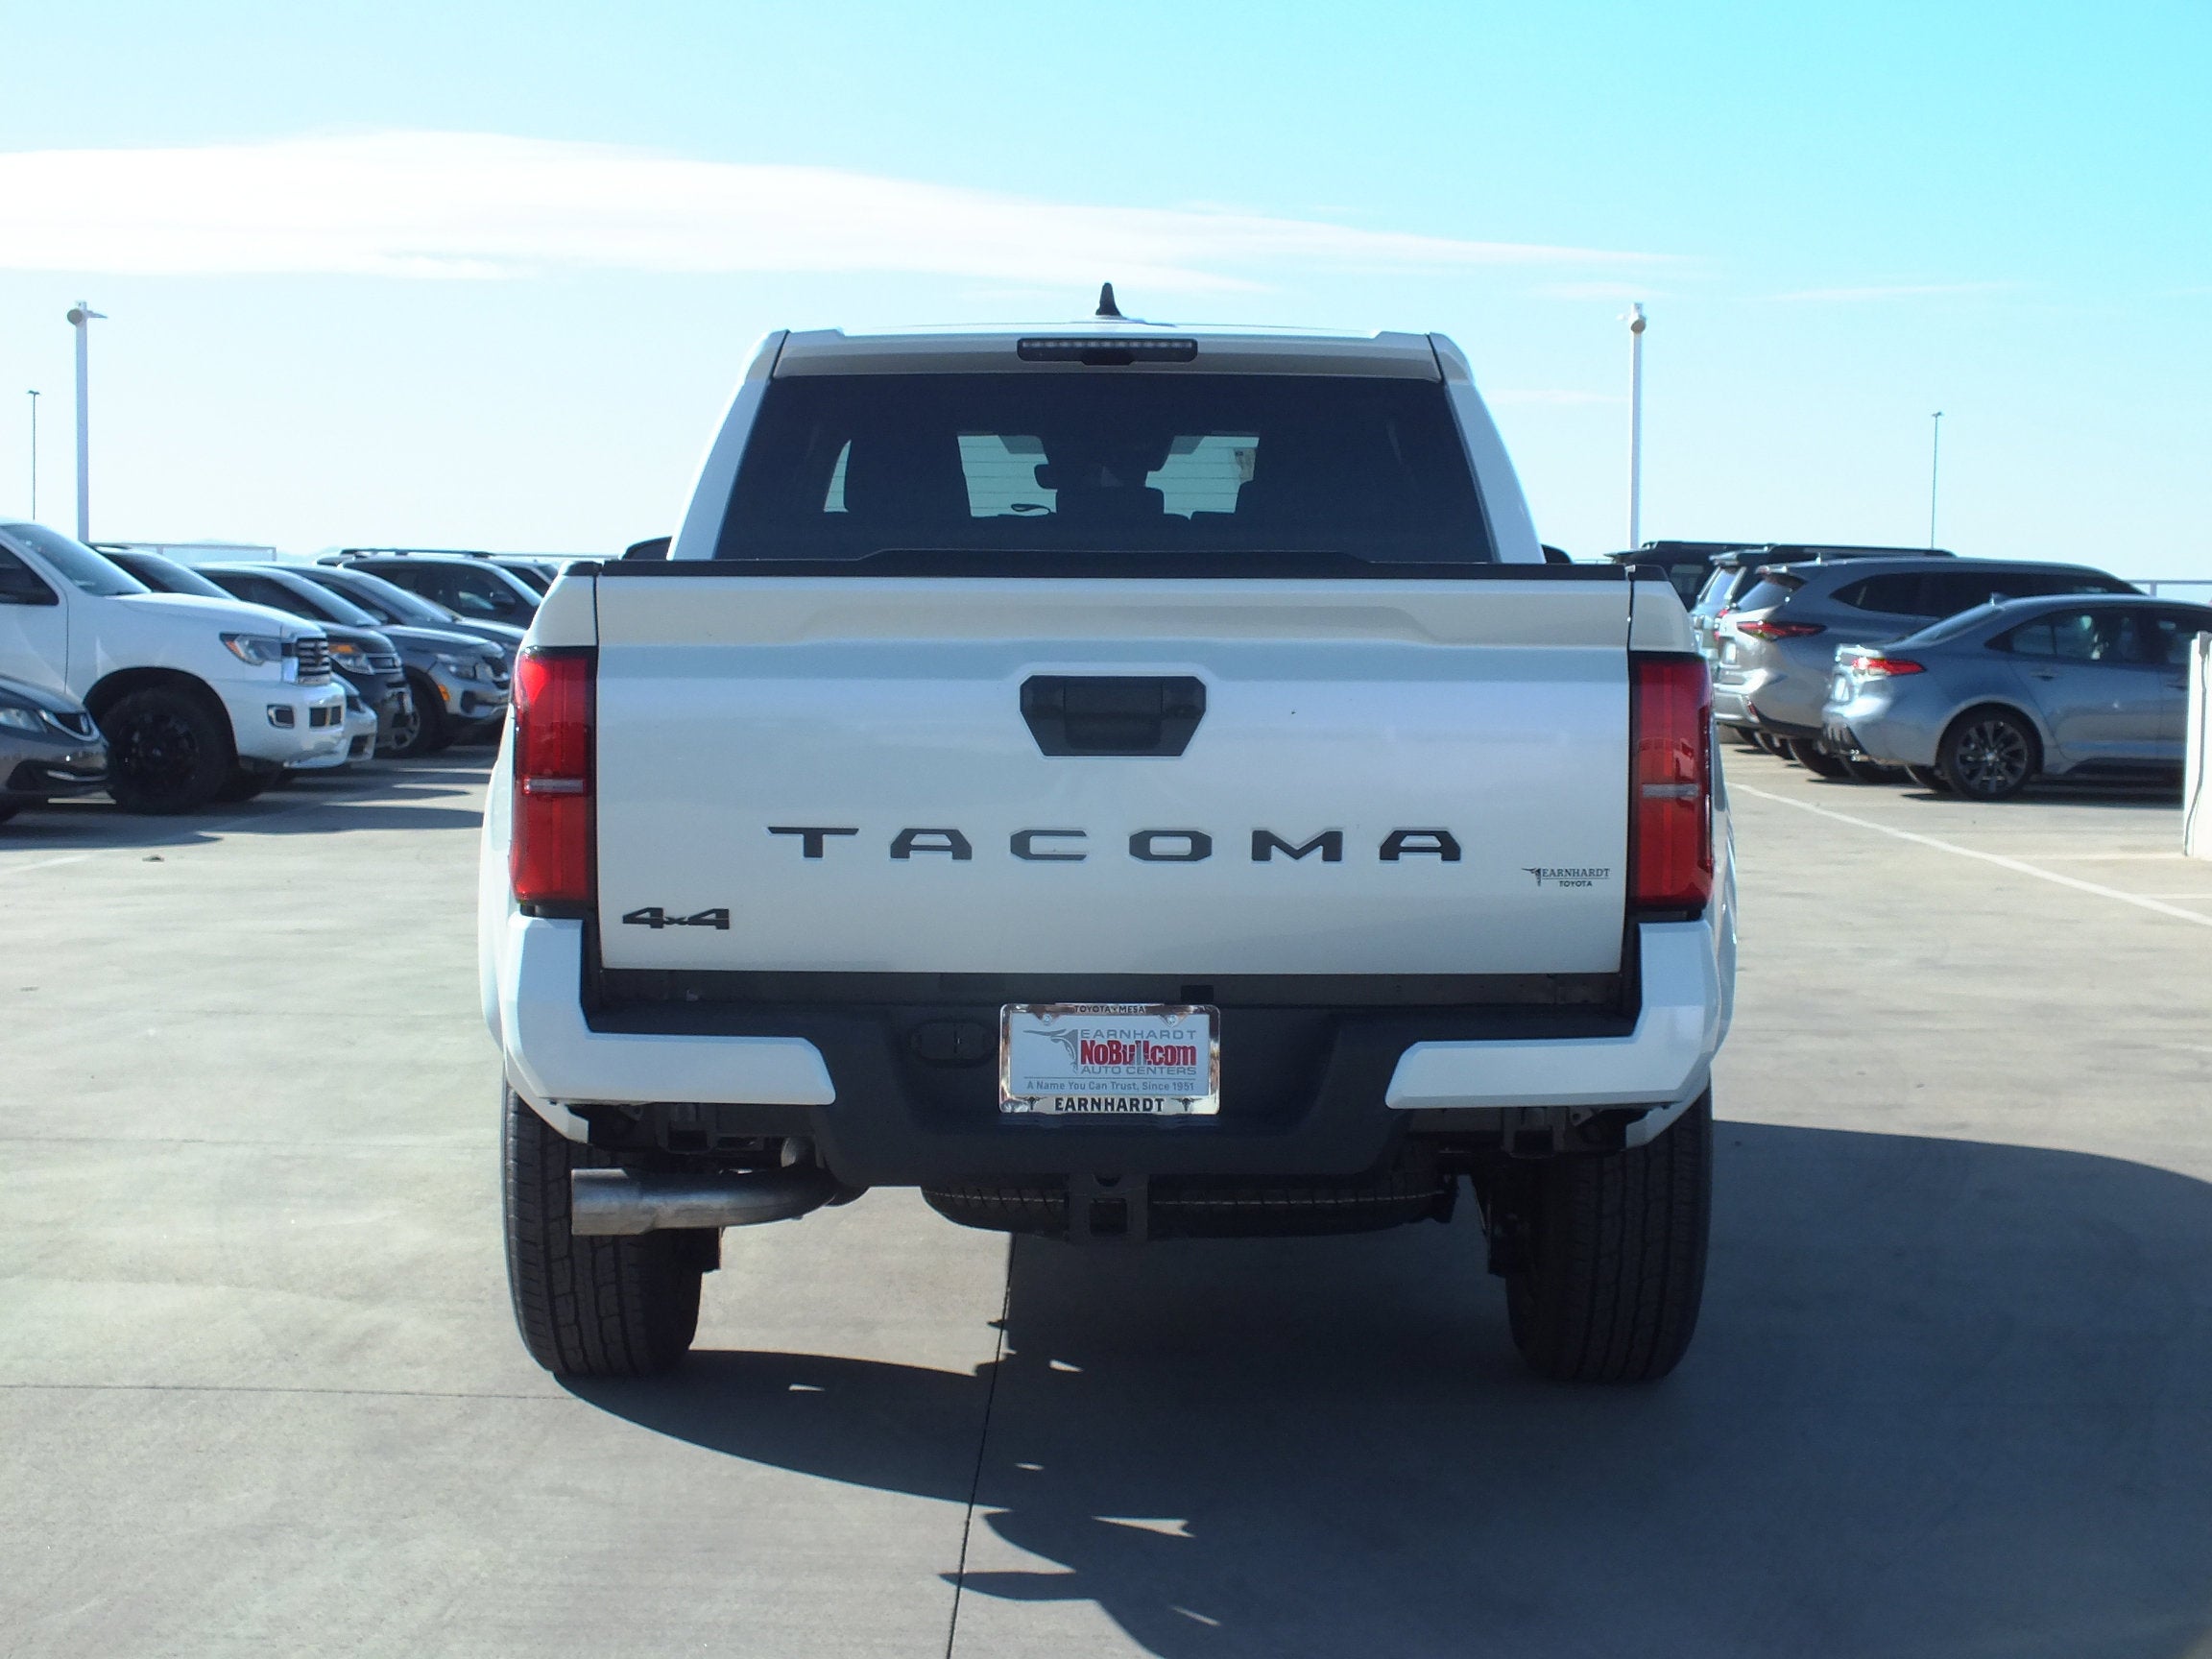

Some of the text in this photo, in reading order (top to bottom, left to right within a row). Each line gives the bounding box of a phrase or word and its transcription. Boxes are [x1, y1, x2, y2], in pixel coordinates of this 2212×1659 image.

[769, 827, 1462, 862] TACOMA
[1542, 868, 1610, 878] EARNHARDT
[1081, 1029, 1196, 1040] EARNHARDT
[1126, 1067, 1196, 1075] CENTERS
[1111, 1082, 1140, 1091] Trust,
[1142, 1082, 1168, 1091] Since
[1056, 1098, 1165, 1112] EARNHARDT
